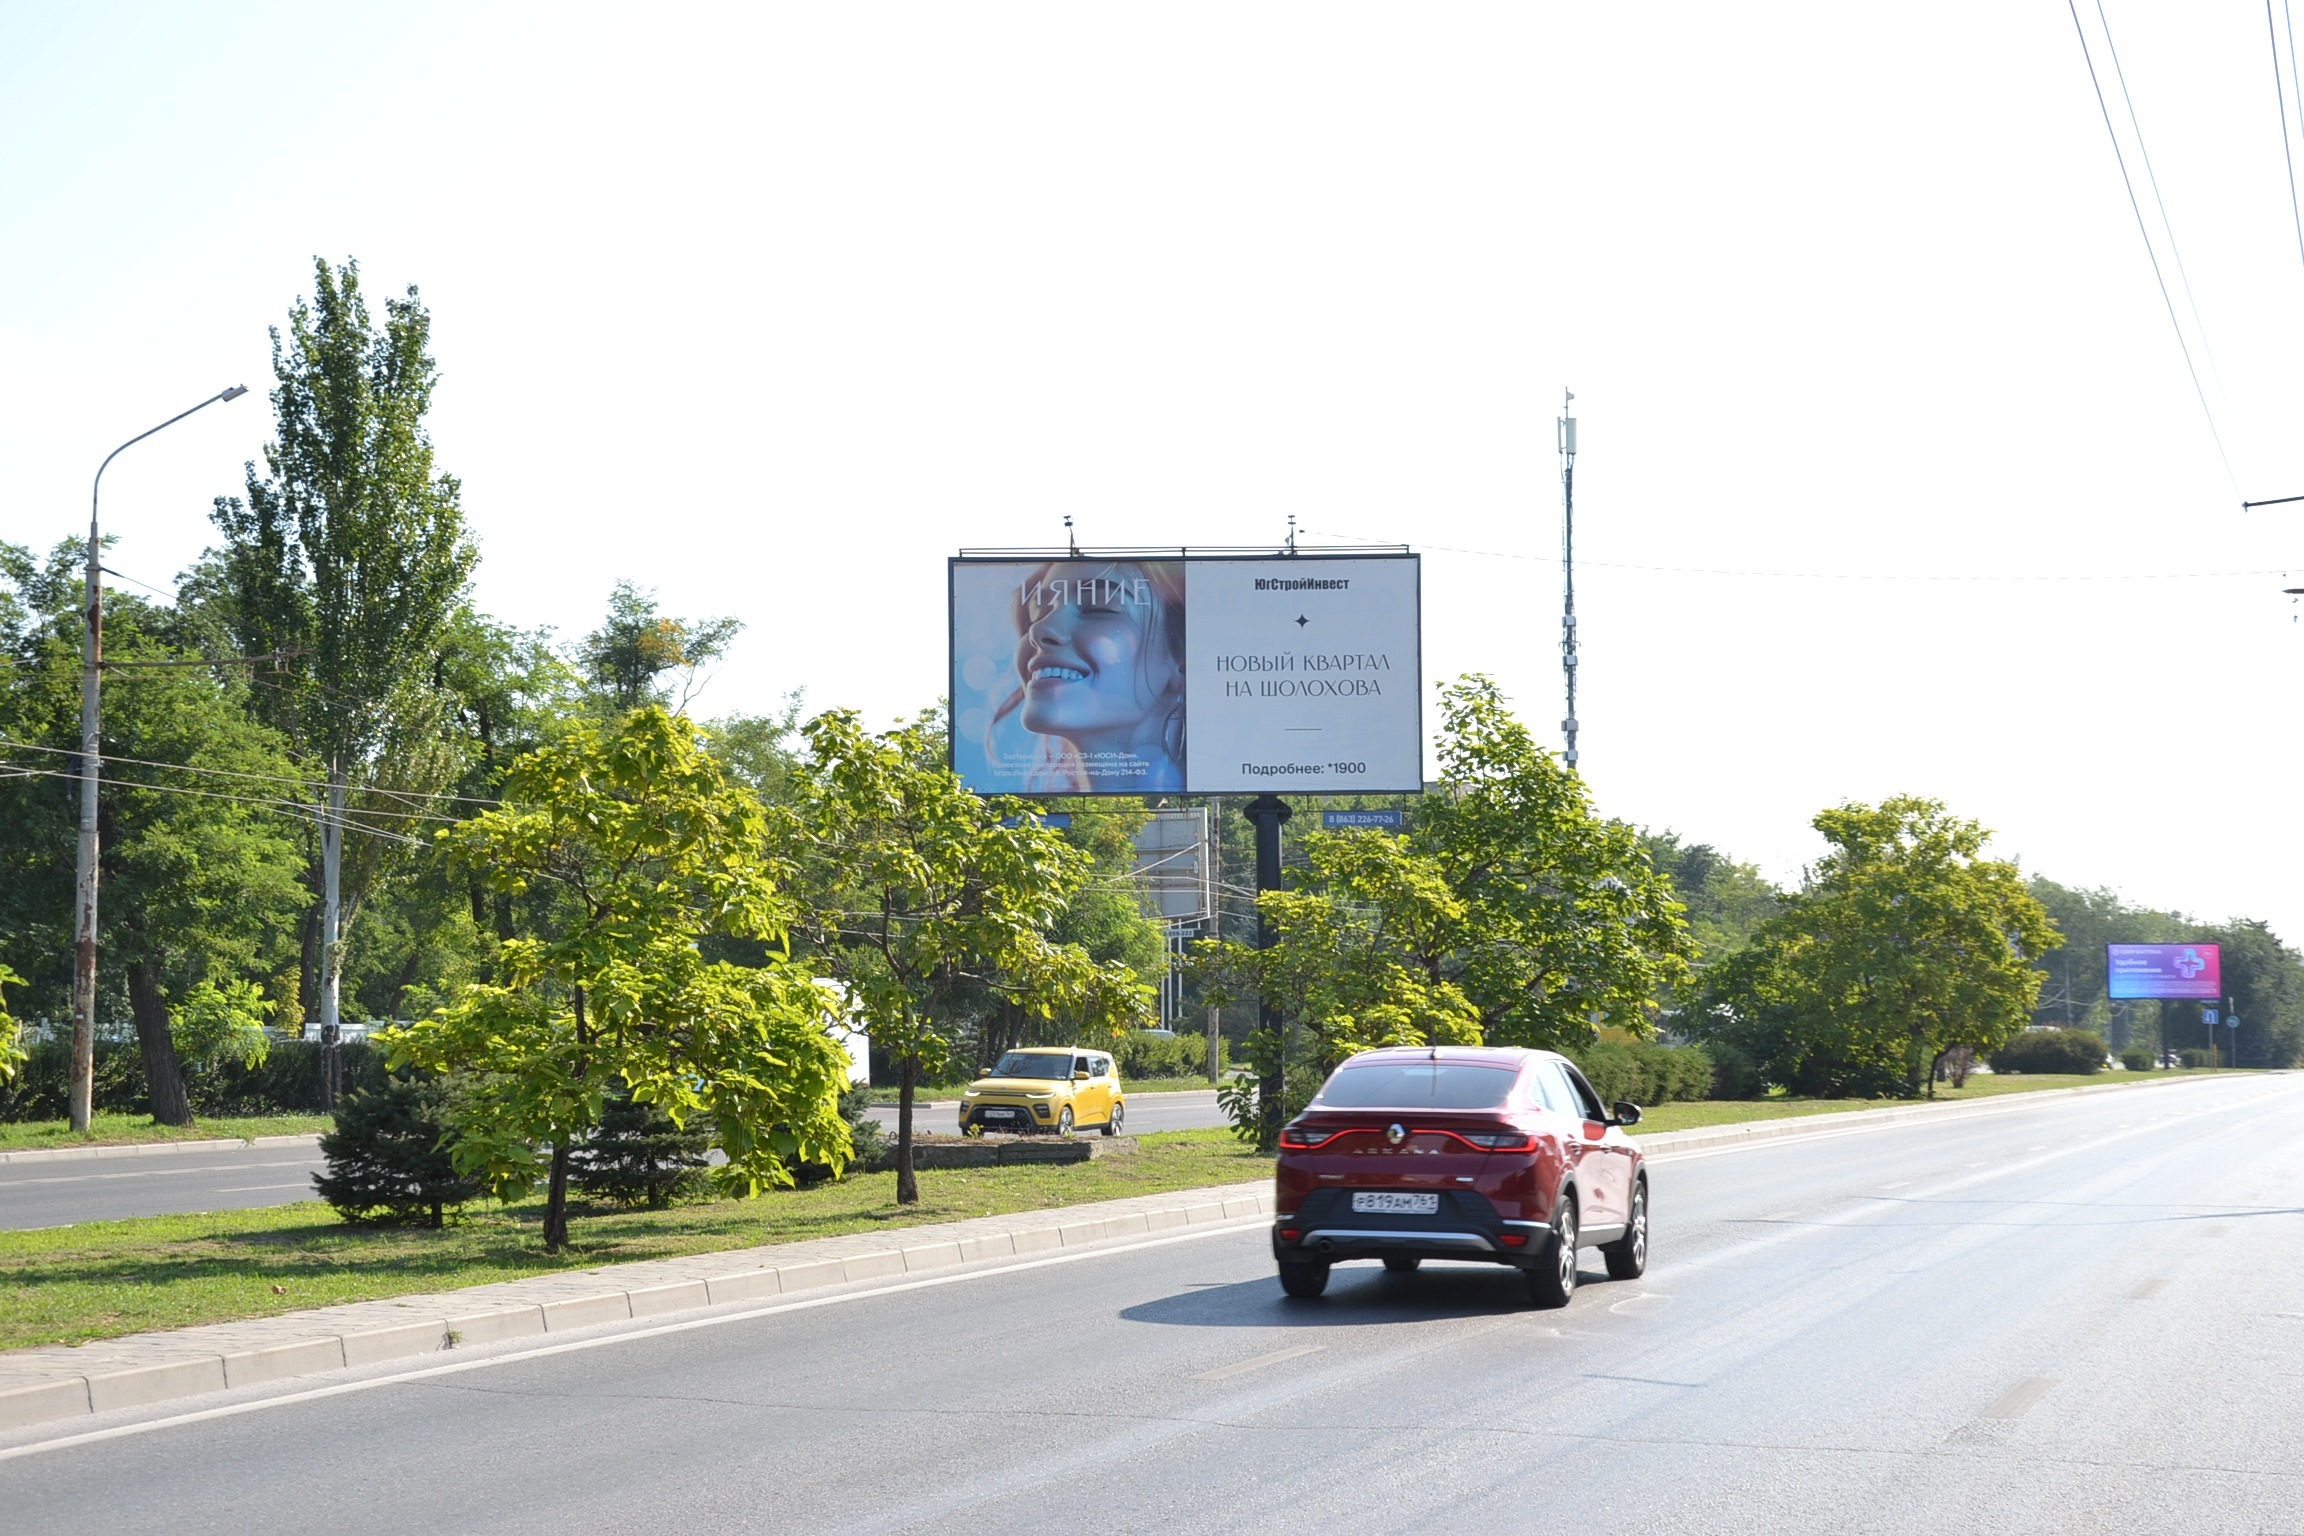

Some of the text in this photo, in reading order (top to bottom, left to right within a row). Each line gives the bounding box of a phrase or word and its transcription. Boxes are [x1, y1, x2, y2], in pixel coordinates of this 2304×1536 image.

[1254, 577, 1350, 592] ЮгСтройИнвест
[1216, 650, 1391, 672] НОВЫЙ КВАРТАЛ
[1226, 679, 1382, 697] НА ШОЛОХОВА
[1128, 759, 1150, 768] сайте
[1241, 763, 1325, 776] Подробнее:
[1328, 814, 1395, 824] 8 (863) 226-77-26
